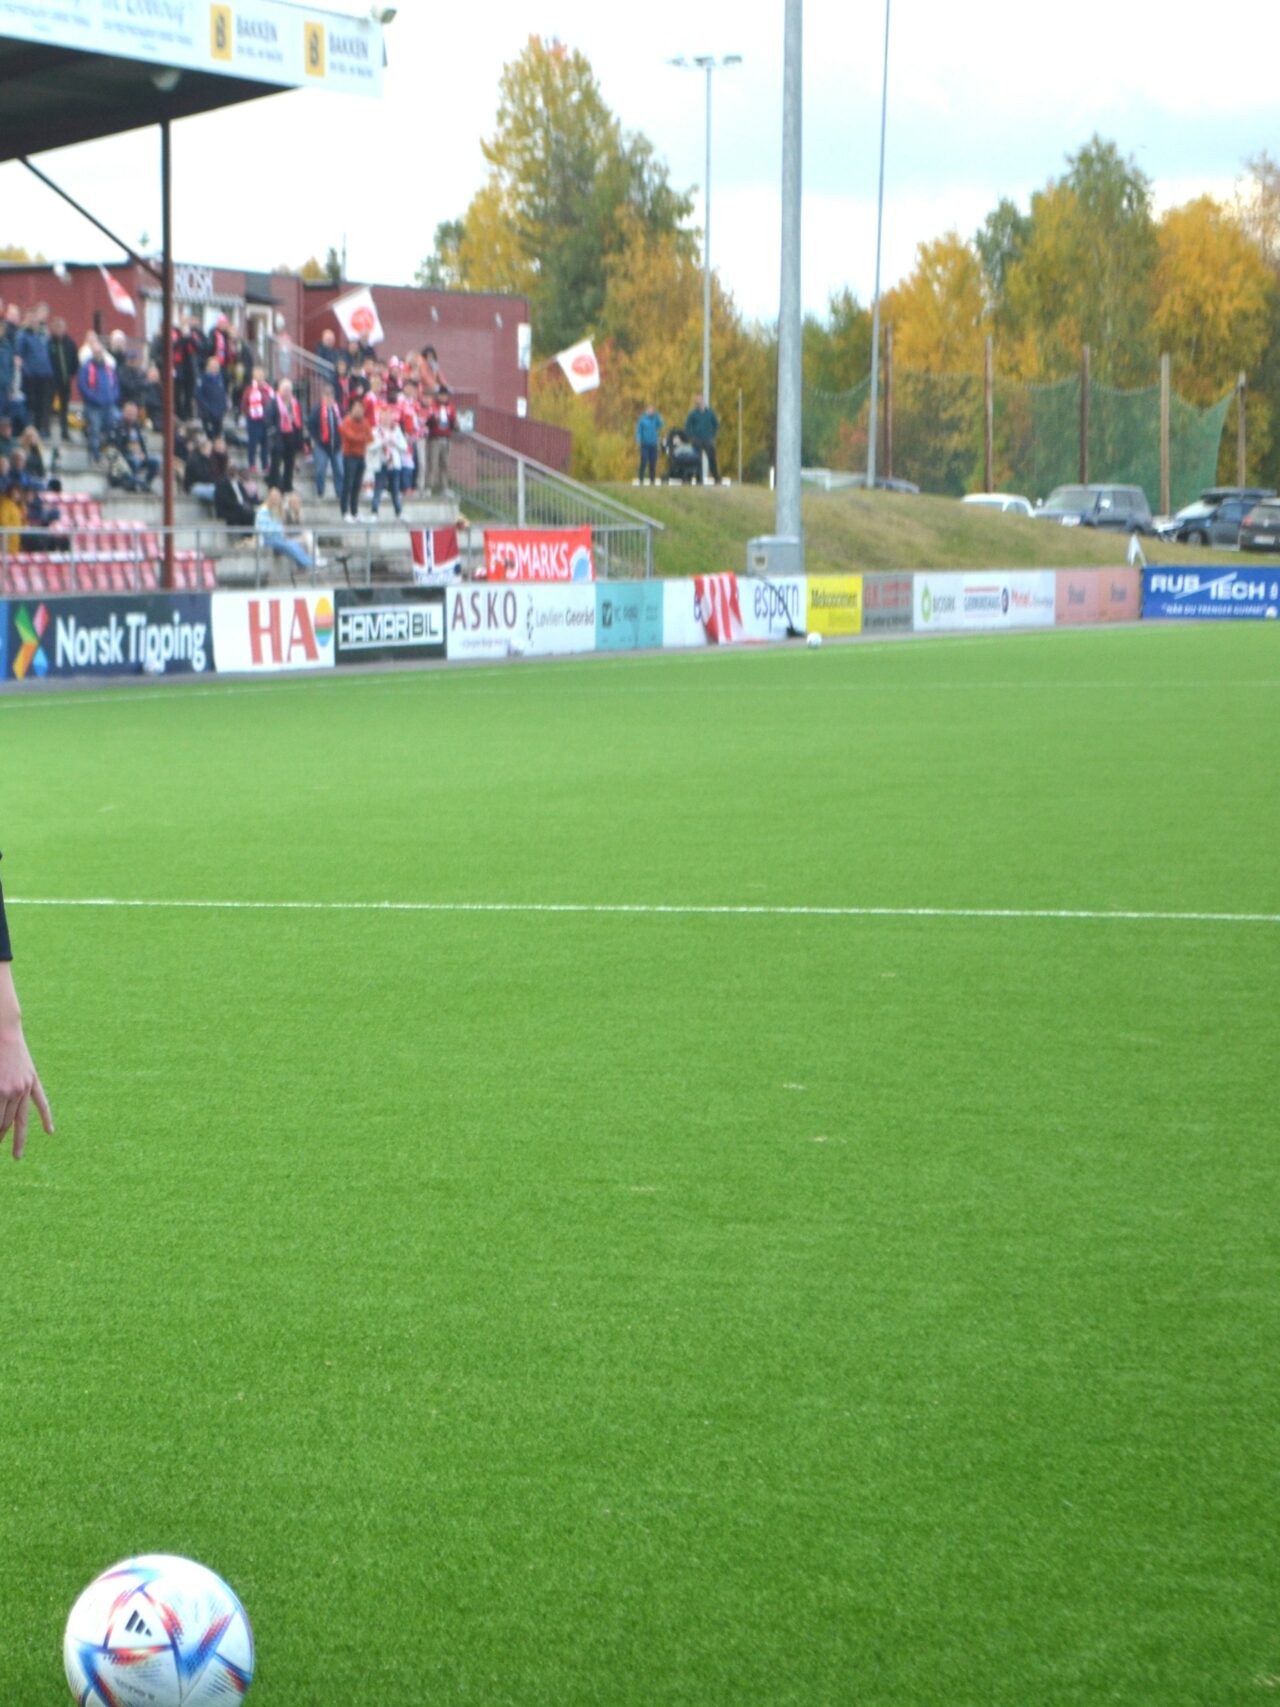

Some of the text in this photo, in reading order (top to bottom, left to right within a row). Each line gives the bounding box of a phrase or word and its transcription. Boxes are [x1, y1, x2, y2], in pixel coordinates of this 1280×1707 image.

[1150, 574, 1200, 593] RUB
[1210, 578, 1266, 600] TECH
[338, 611, 439, 644] HAMAR BIL
[451, 589, 518, 631] ASKO
[55, 611, 206, 674] Norsk Tipping
[248, 598, 319, 665] HA
